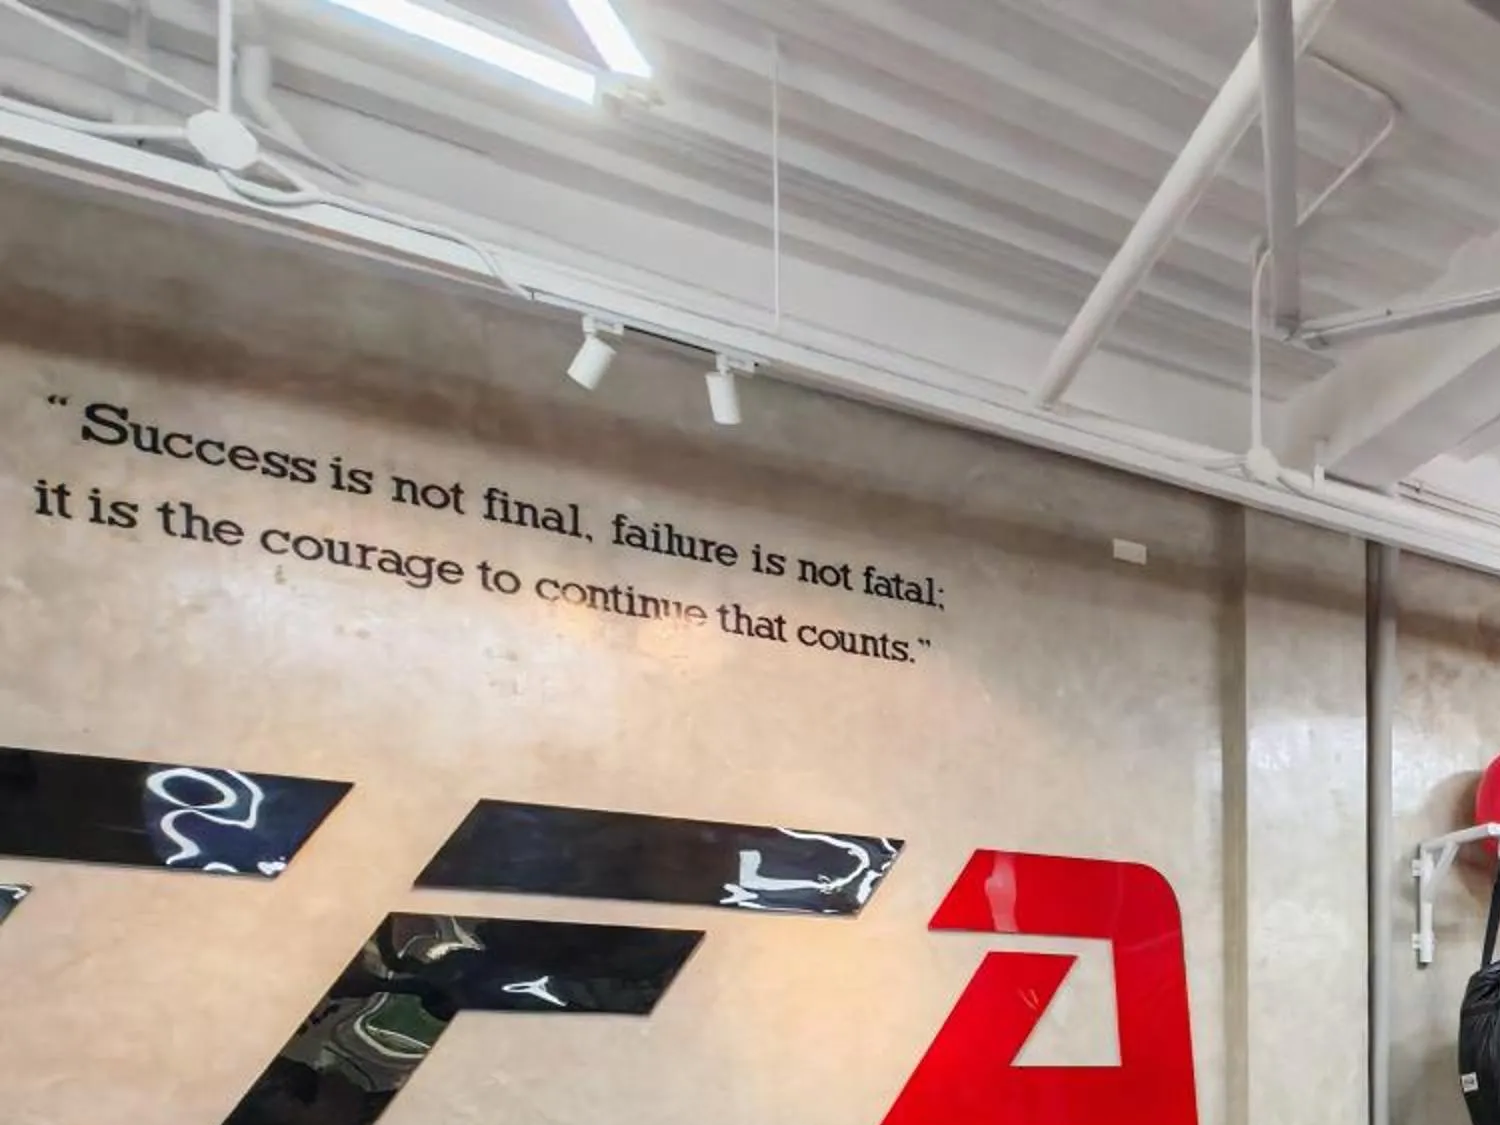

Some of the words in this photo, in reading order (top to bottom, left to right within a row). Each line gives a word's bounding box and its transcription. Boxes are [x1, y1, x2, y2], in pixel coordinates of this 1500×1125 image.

[33, 478, 72, 520] it
[87, 486, 140, 530] is
[155, 501, 245, 546] the
[259, 527, 465, 589] courage
[476, 560, 522, 595] to
[534, 577, 708, 627] continue
[716, 603, 788, 644] that
[328, 456, 374, 496] is
[391, 475, 466, 516] not
[482, 486, 595, 543] final,
[610, 513, 739, 567] failure
[750, 542, 787, 578] is
[797, 556, 853, 592] not
